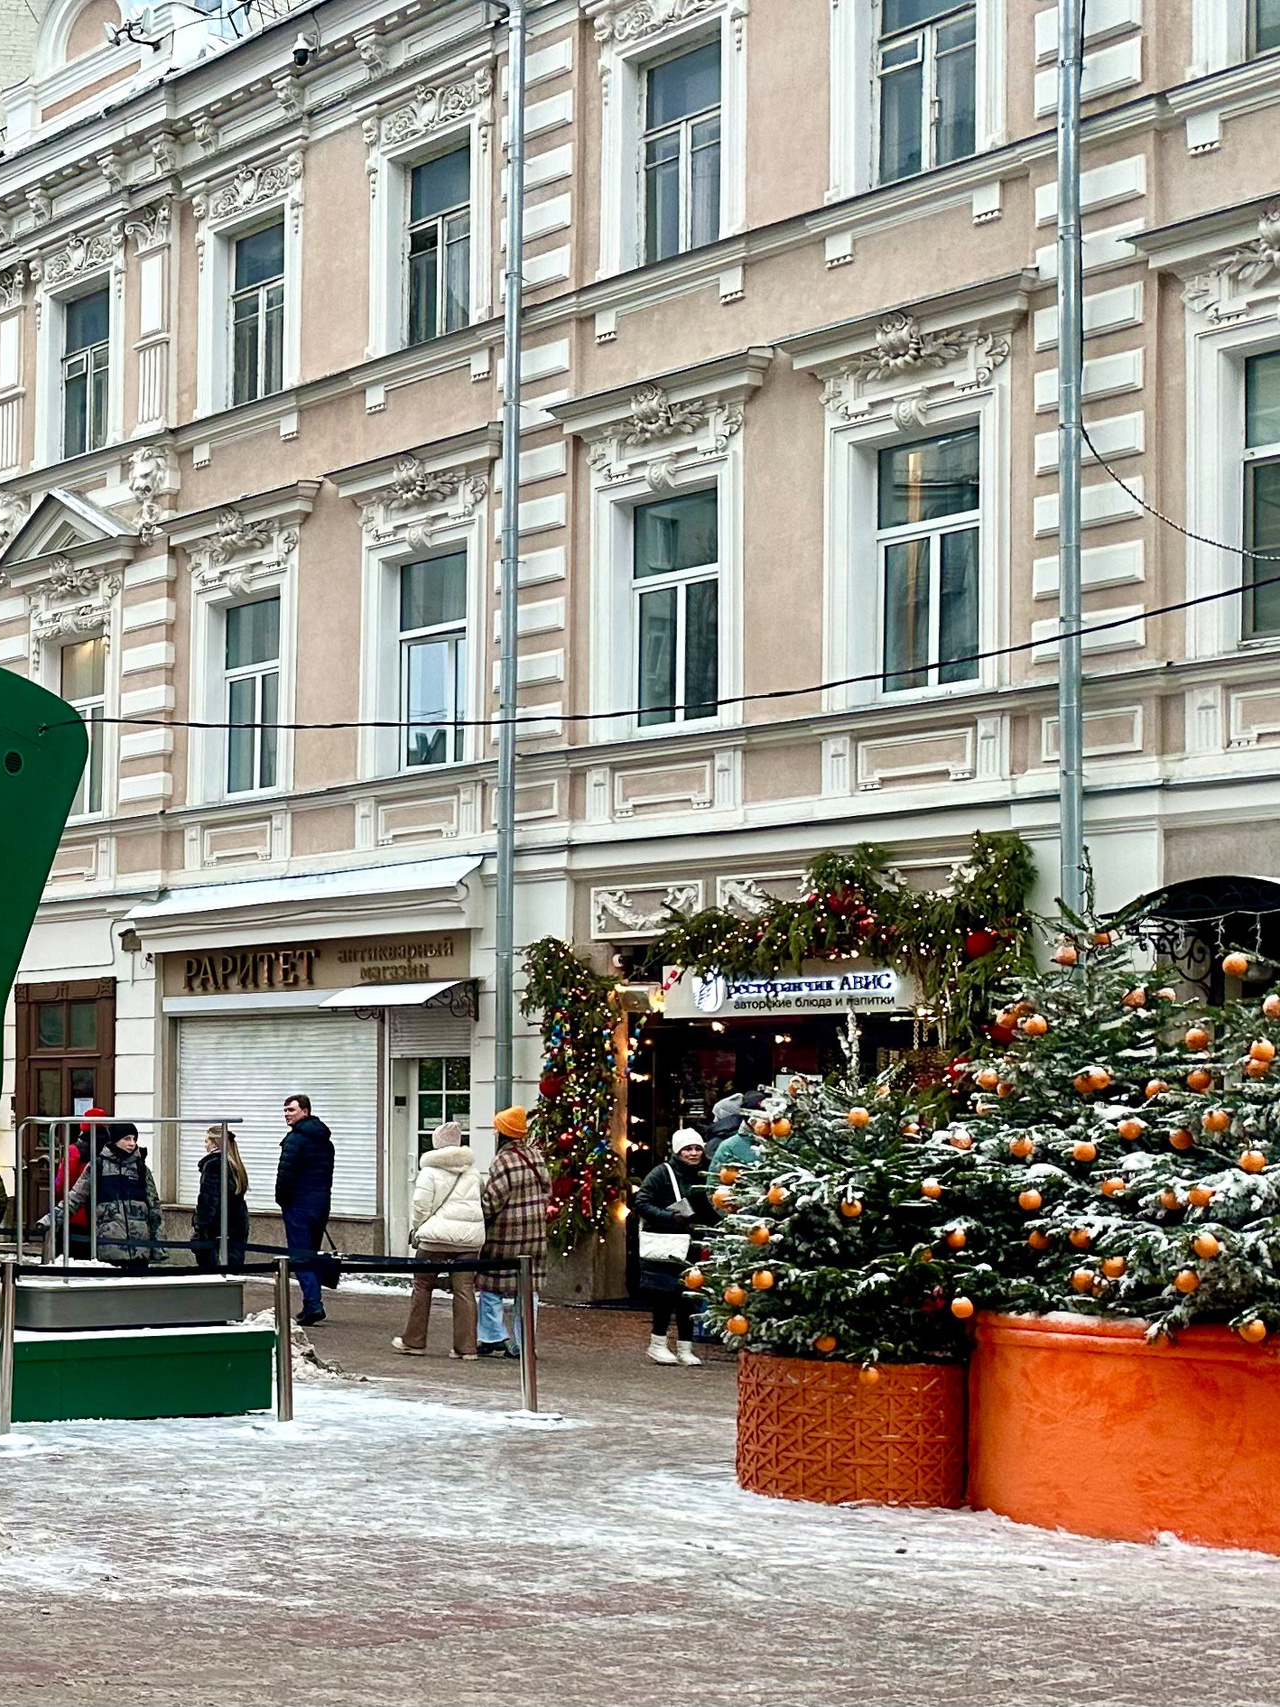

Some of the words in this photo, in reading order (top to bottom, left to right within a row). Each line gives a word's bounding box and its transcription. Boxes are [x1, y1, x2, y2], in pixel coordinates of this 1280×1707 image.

[337, 937, 454, 963] антикварный
[183, 949, 319, 991] РАРИТЕТ
[359, 963, 430, 980] магазин
[726, 979, 835, 999] ресторанчик
[839, 973, 892, 991] АВИС
[795, 996, 832, 1009] блюда
[835, 997, 843, 1006] и
